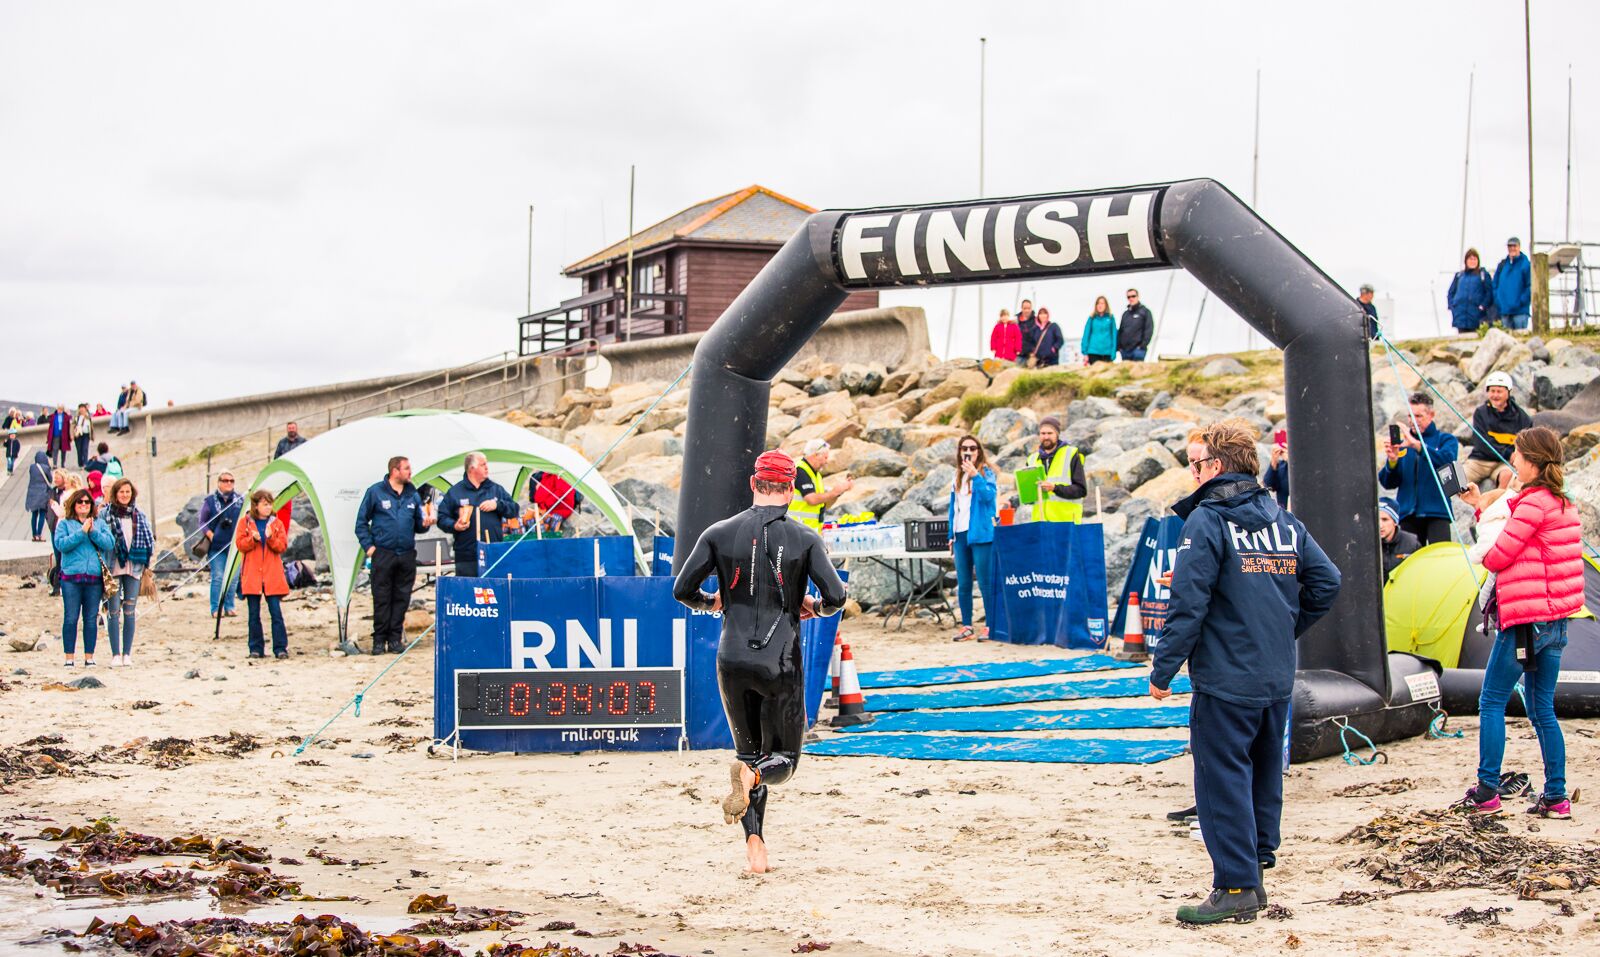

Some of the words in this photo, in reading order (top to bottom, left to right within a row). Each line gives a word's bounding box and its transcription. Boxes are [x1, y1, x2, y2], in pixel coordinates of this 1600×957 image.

[841, 192, 1155, 280] FINISH
[1227, 521, 1298, 553] RNLI
[1241, 557, 1255, 566] THE
[1241, 565, 1262, 573] SAVES
[1279, 566, 1287, 575] AT
[1288, 566, 1297, 575] SE
[1005, 573, 1019, 585] Ask
[1020, 574, 1032, 584] us
[1018, 588, 1031, 599] on
[446, 603, 499, 618] Lifeboats
[509, 682, 655, 716] 0:34:07
[561, 727, 640, 744] rnli.org.uk
